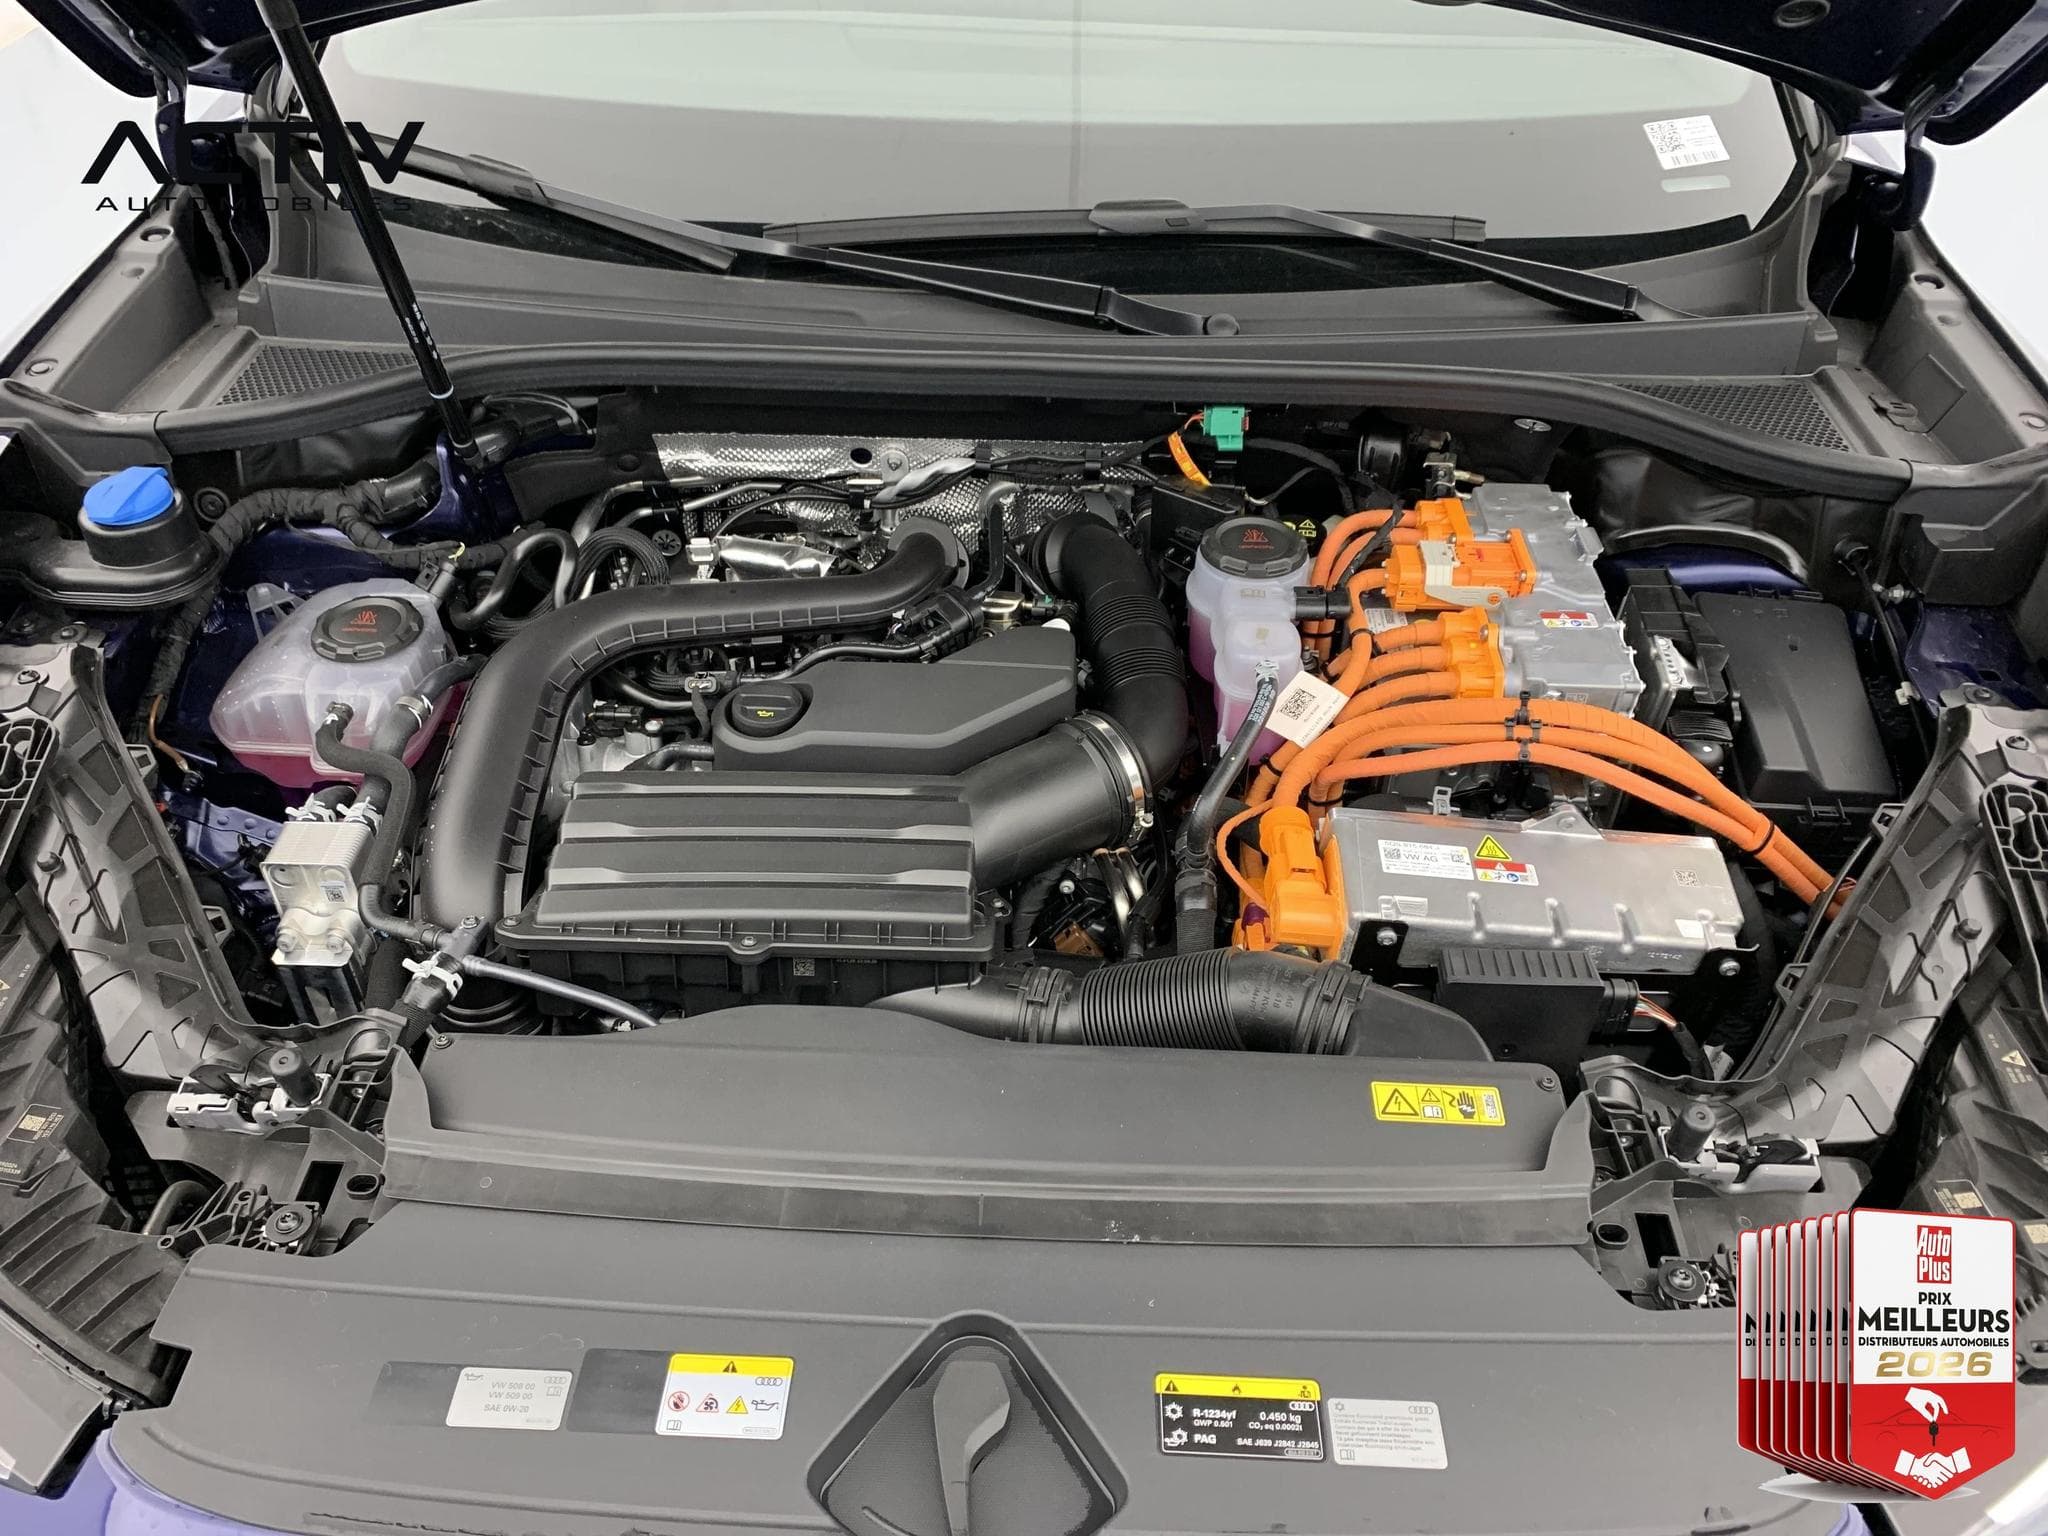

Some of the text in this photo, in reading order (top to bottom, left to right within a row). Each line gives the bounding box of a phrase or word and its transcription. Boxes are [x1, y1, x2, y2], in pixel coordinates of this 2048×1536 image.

[1402, 853, 1438, 863] VW AG
[491, 1382, 536, 1391] VW 508 00
[489, 1391, 533, 1400] VW 509 00
[484, 1404, 530, 1413] SAE 0W-20
[1192, 1408, 1236, 1420] R-1234yf
[1259, 1411, 1301, 1423] 0.450 kg
[1194, 1419, 1212, 1427] GWP
[1193, 1434, 1216, 1444] PAG
